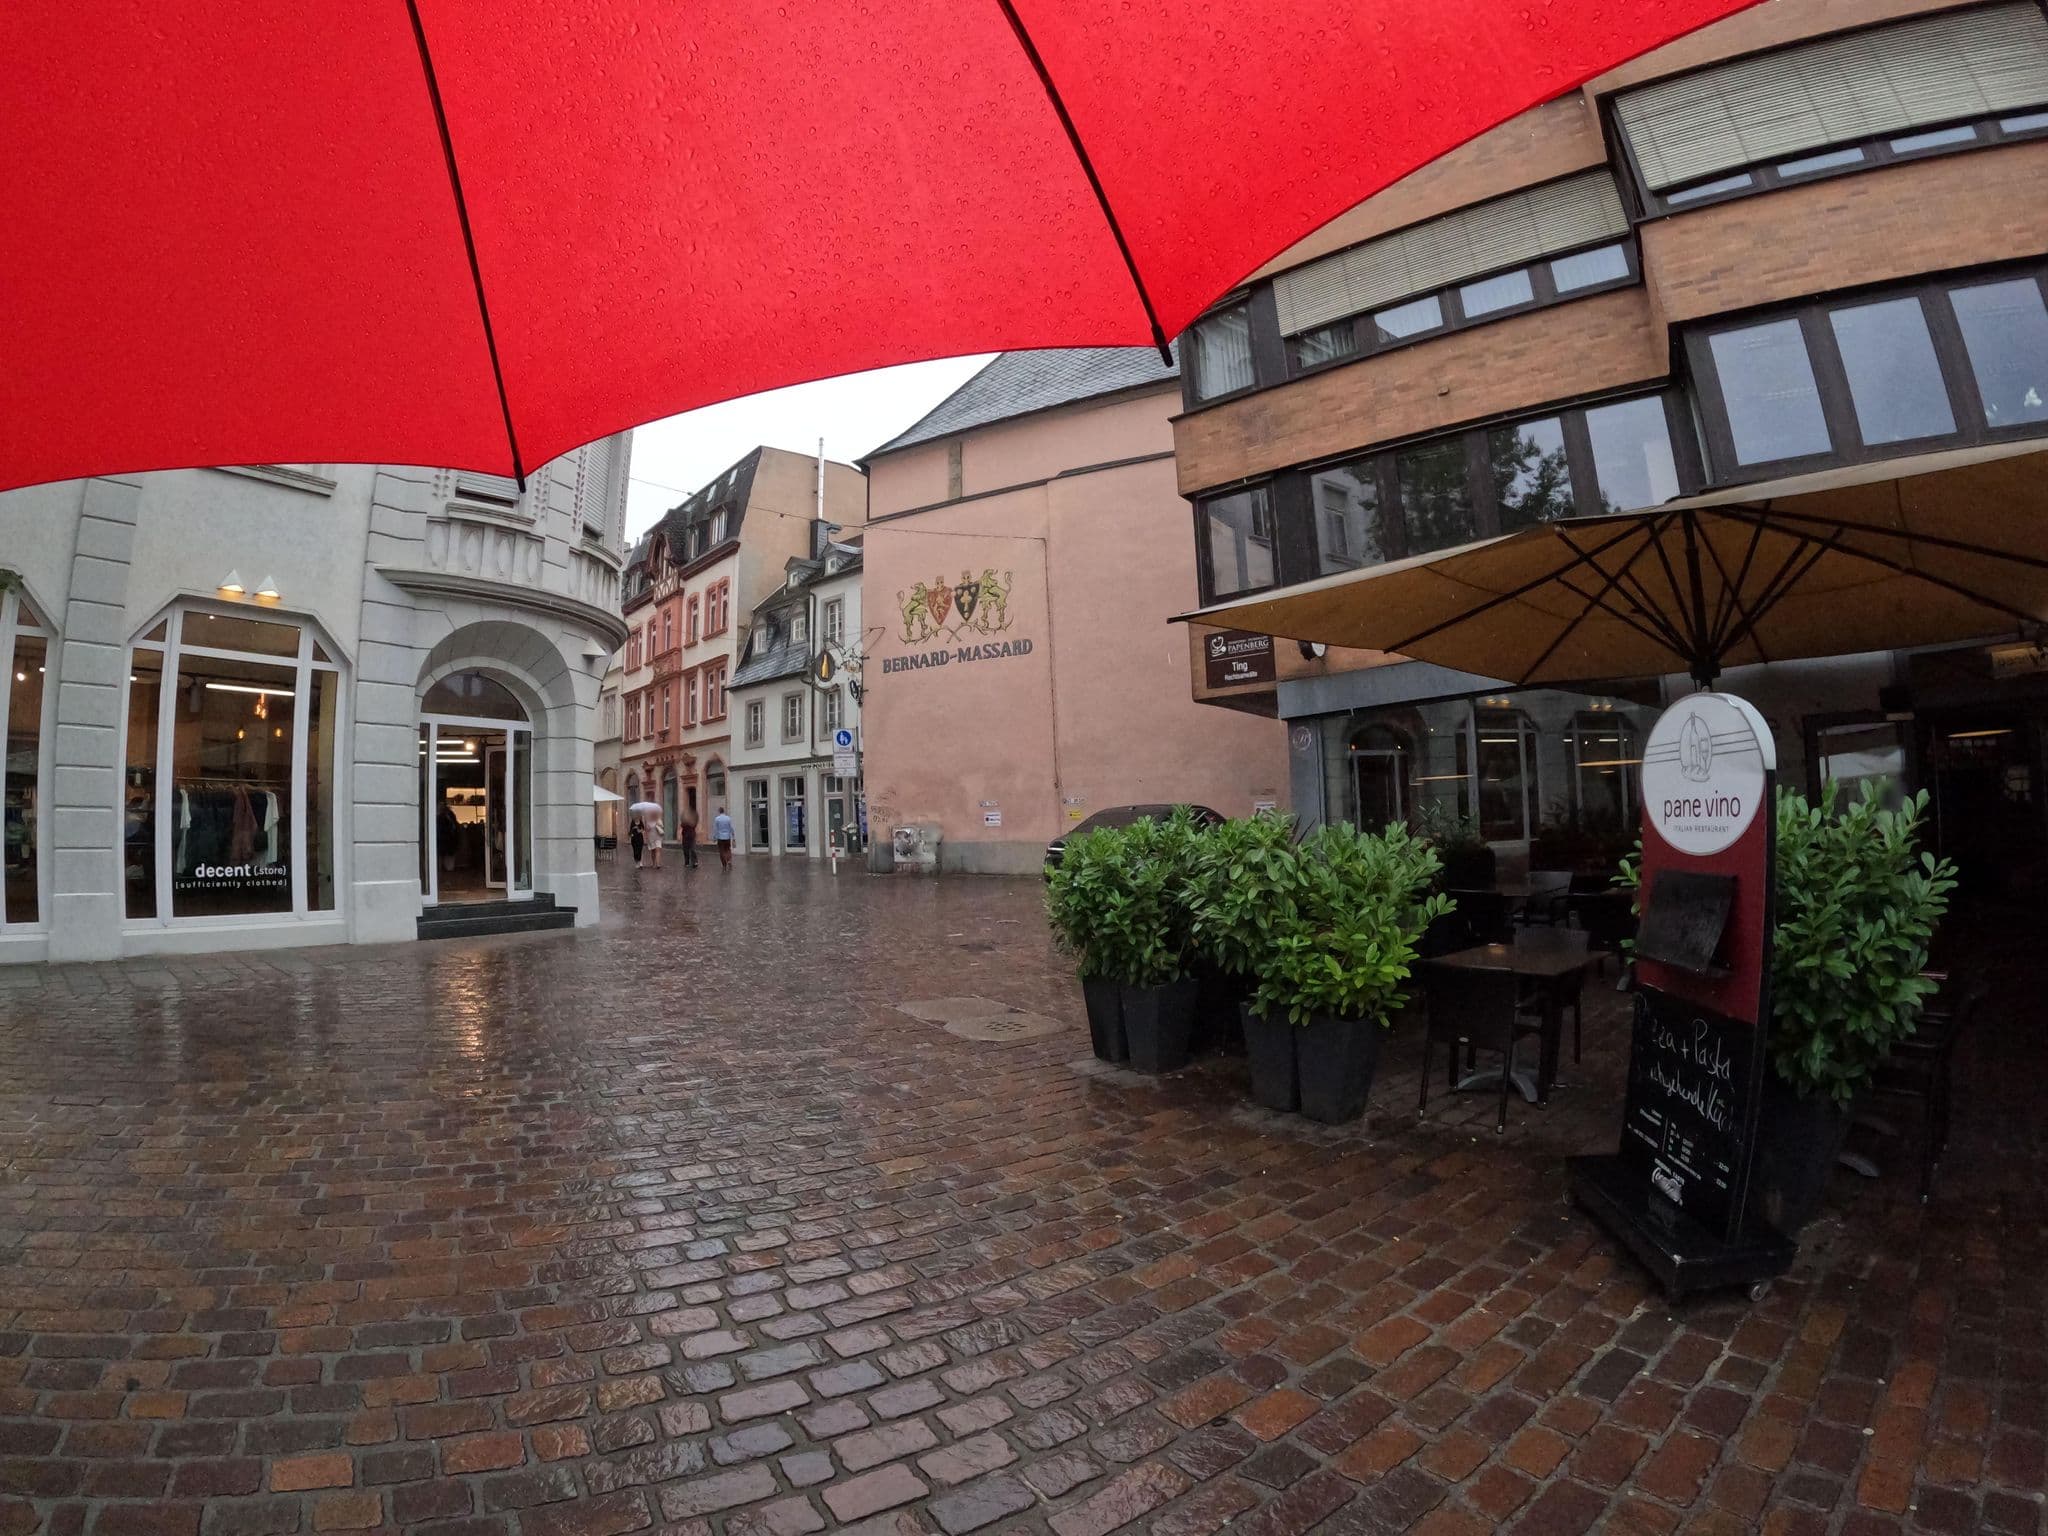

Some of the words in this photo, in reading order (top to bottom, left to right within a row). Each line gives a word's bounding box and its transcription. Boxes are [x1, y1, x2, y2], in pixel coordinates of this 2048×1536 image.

[1228, 639, 1270, 653] PAPENBERG
[883, 639, 1033, 674] BERNARD-MASSARD
[1232, 662, 1248, 673] Ting
[1664, 799, 1701, 825] pane
[1705, 789, 1741, 818] vino
[1695, 824, 1729, 833] RESTAURANT
[195, 863, 251, 878] decent
[1689, 1018, 1730, 1081] Pasta
